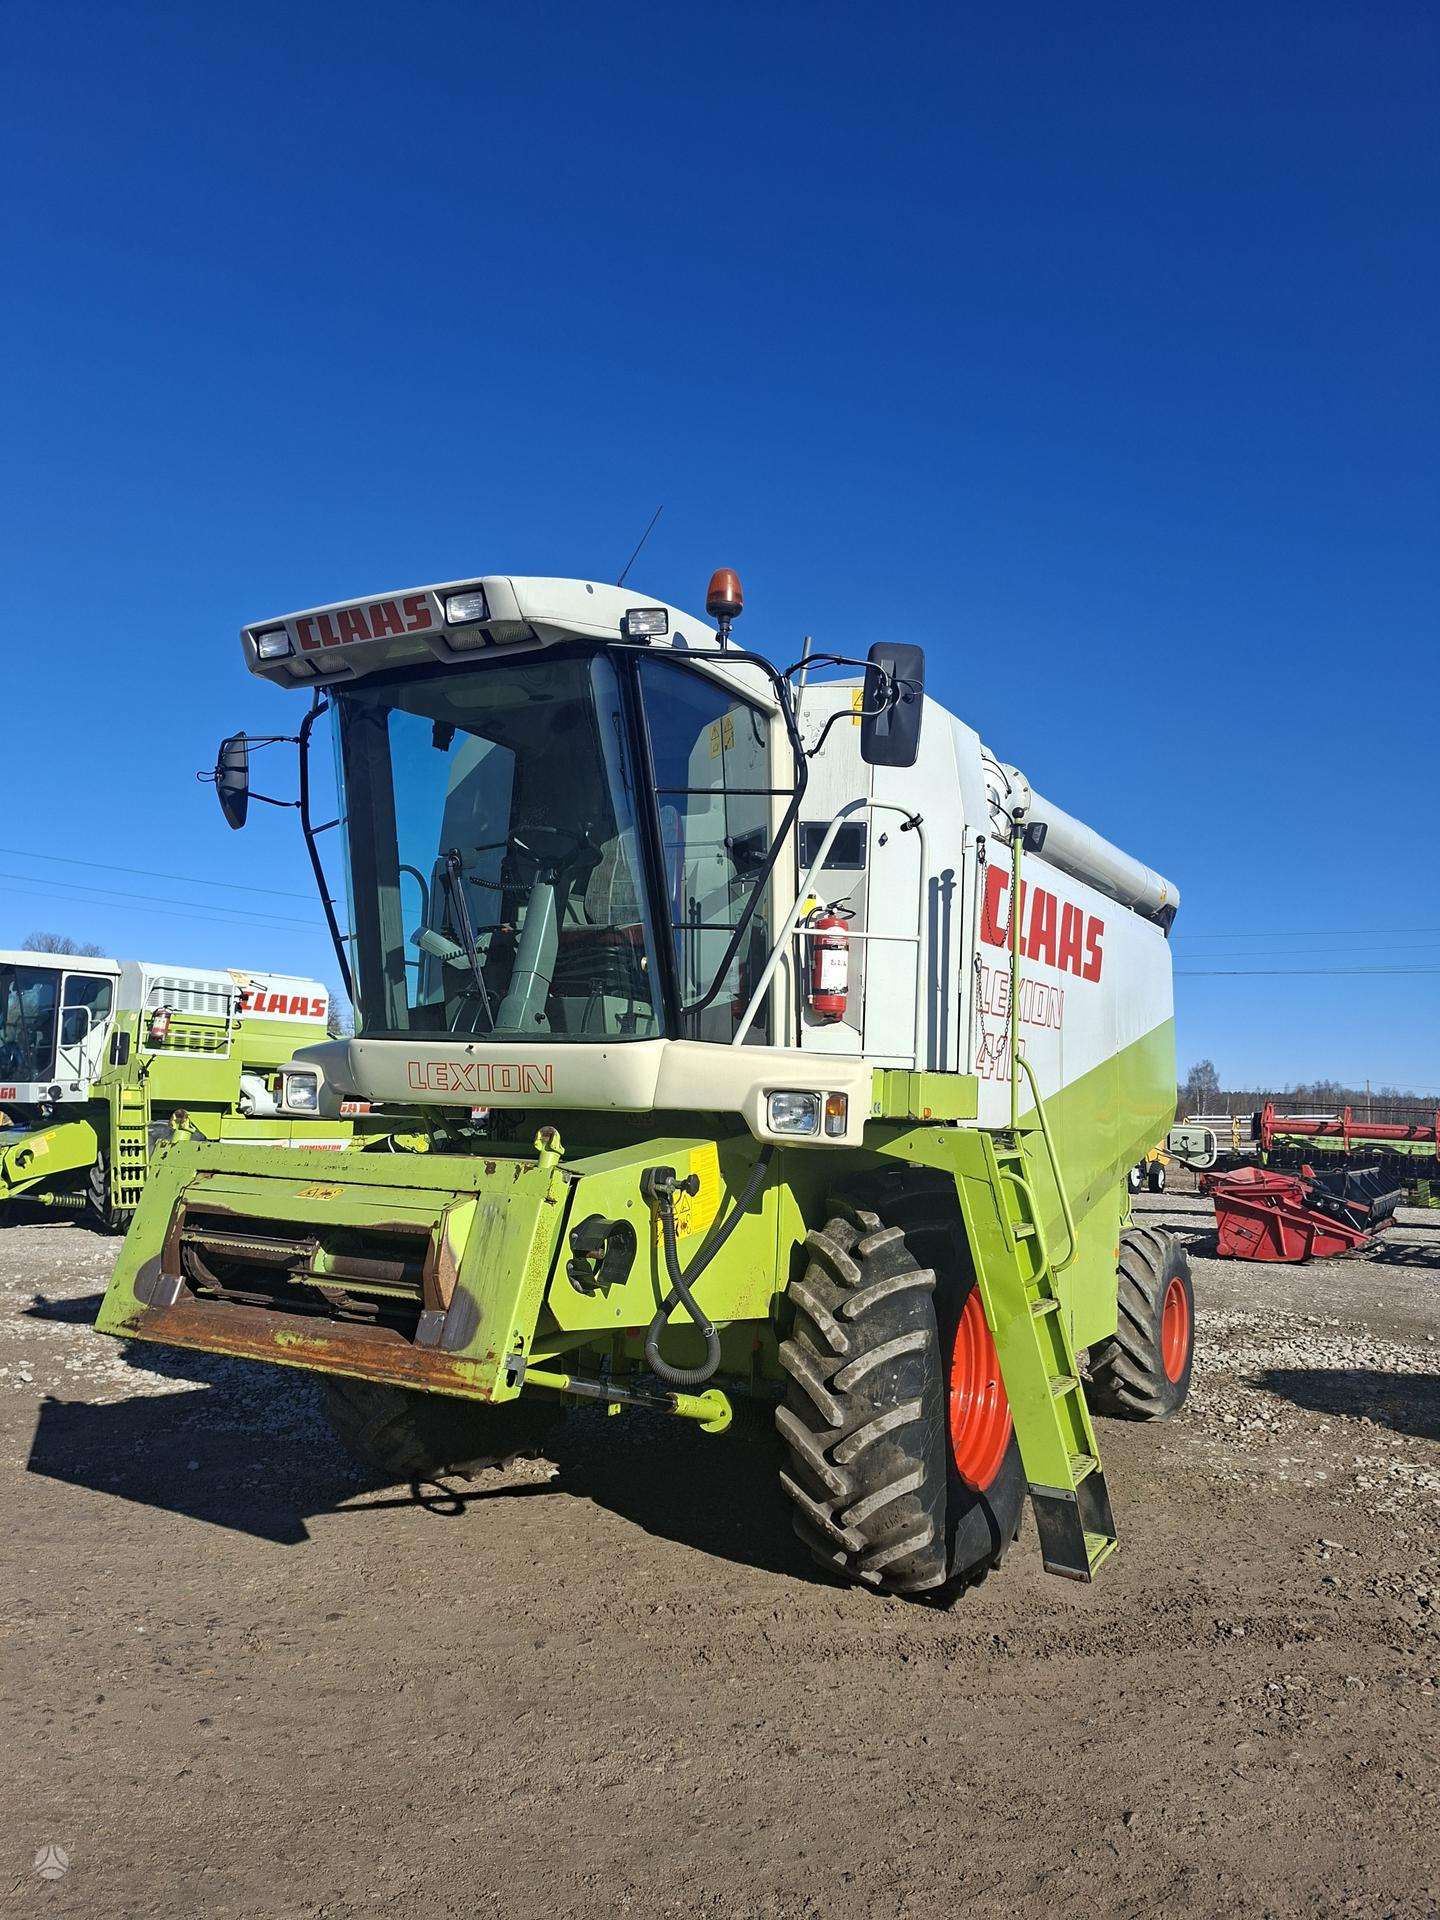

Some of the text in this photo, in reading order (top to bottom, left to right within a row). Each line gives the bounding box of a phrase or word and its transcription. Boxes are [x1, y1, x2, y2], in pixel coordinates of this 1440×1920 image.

[296, 594, 432, 650] CLAAS
[979, 863, 1104, 983] CLAAS
[408, 1061, 553, 1093] LEXION
